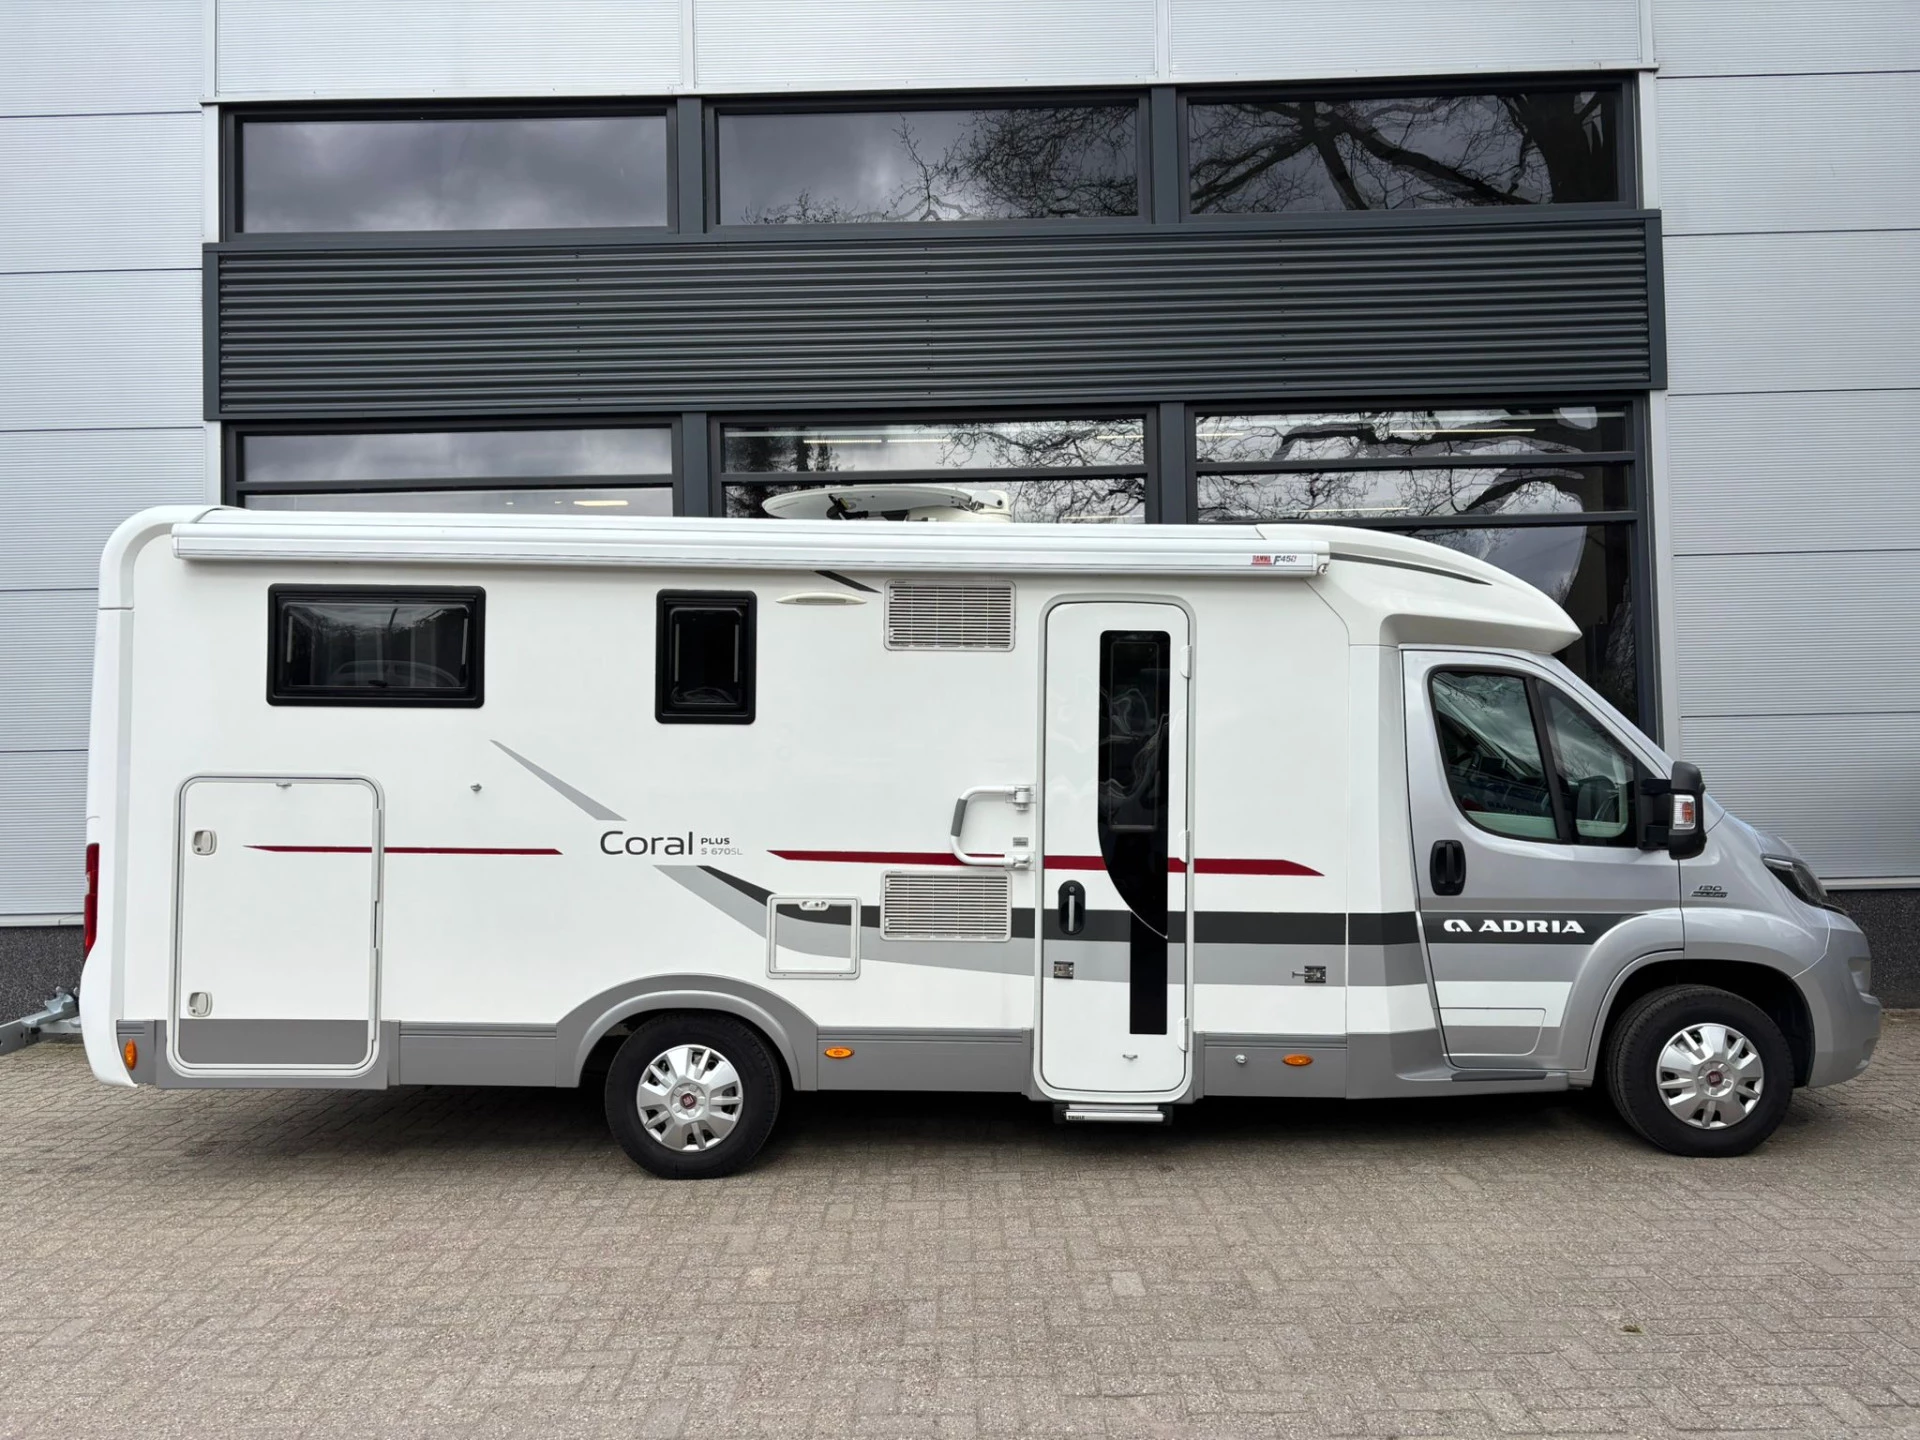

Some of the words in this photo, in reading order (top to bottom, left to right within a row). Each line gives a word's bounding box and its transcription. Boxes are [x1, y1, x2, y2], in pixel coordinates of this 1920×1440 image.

[1273, 555, 1298, 565] F450
[600, 830, 693, 855] Coral
[701, 837, 730, 845] PLUS
[701, 847, 708, 855] S
[711, 847, 743, 855] 670SL
[1478, 919, 1585, 934] ADRIA
